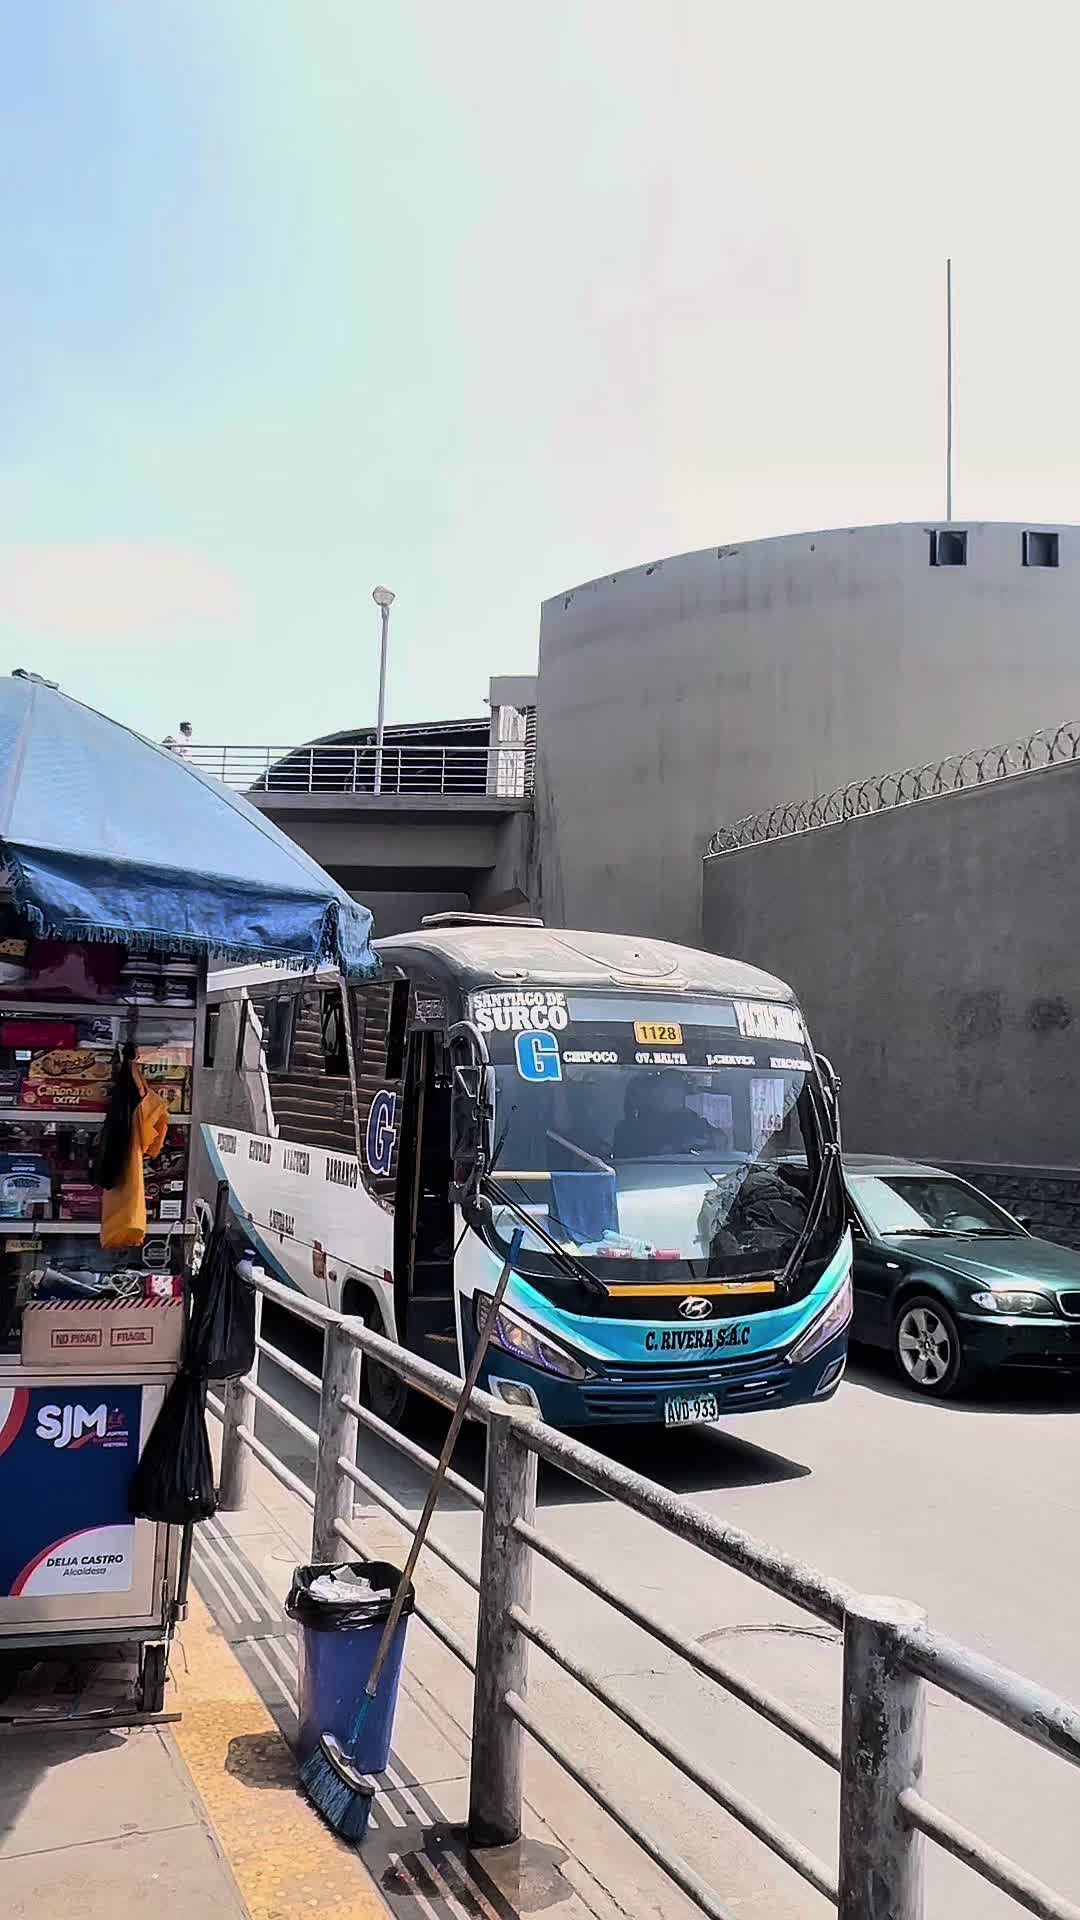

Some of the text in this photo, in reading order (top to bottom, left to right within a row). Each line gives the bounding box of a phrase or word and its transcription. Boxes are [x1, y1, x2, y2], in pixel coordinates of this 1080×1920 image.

[474, 992, 566, 1009] SANTIAGO DE
[475, 1005, 568, 1033] SURCO
[640, 1026, 677, 1040] 1128
[514, 1029, 562, 1082] G
[366, 1089, 397, 1176] G
[56, 1334, 69, 1344] NO
[645, 1331, 658, 1351] C.
[661, 1329, 713, 1351] RIVERA
[667, 1399, 716, 1423] AVD-933
[35, 1404, 108, 1448] SJM
[46, 1554, 123, 1567] DELIA CASTRO
[62, 1567, 107, 1577] Alcaldesa
